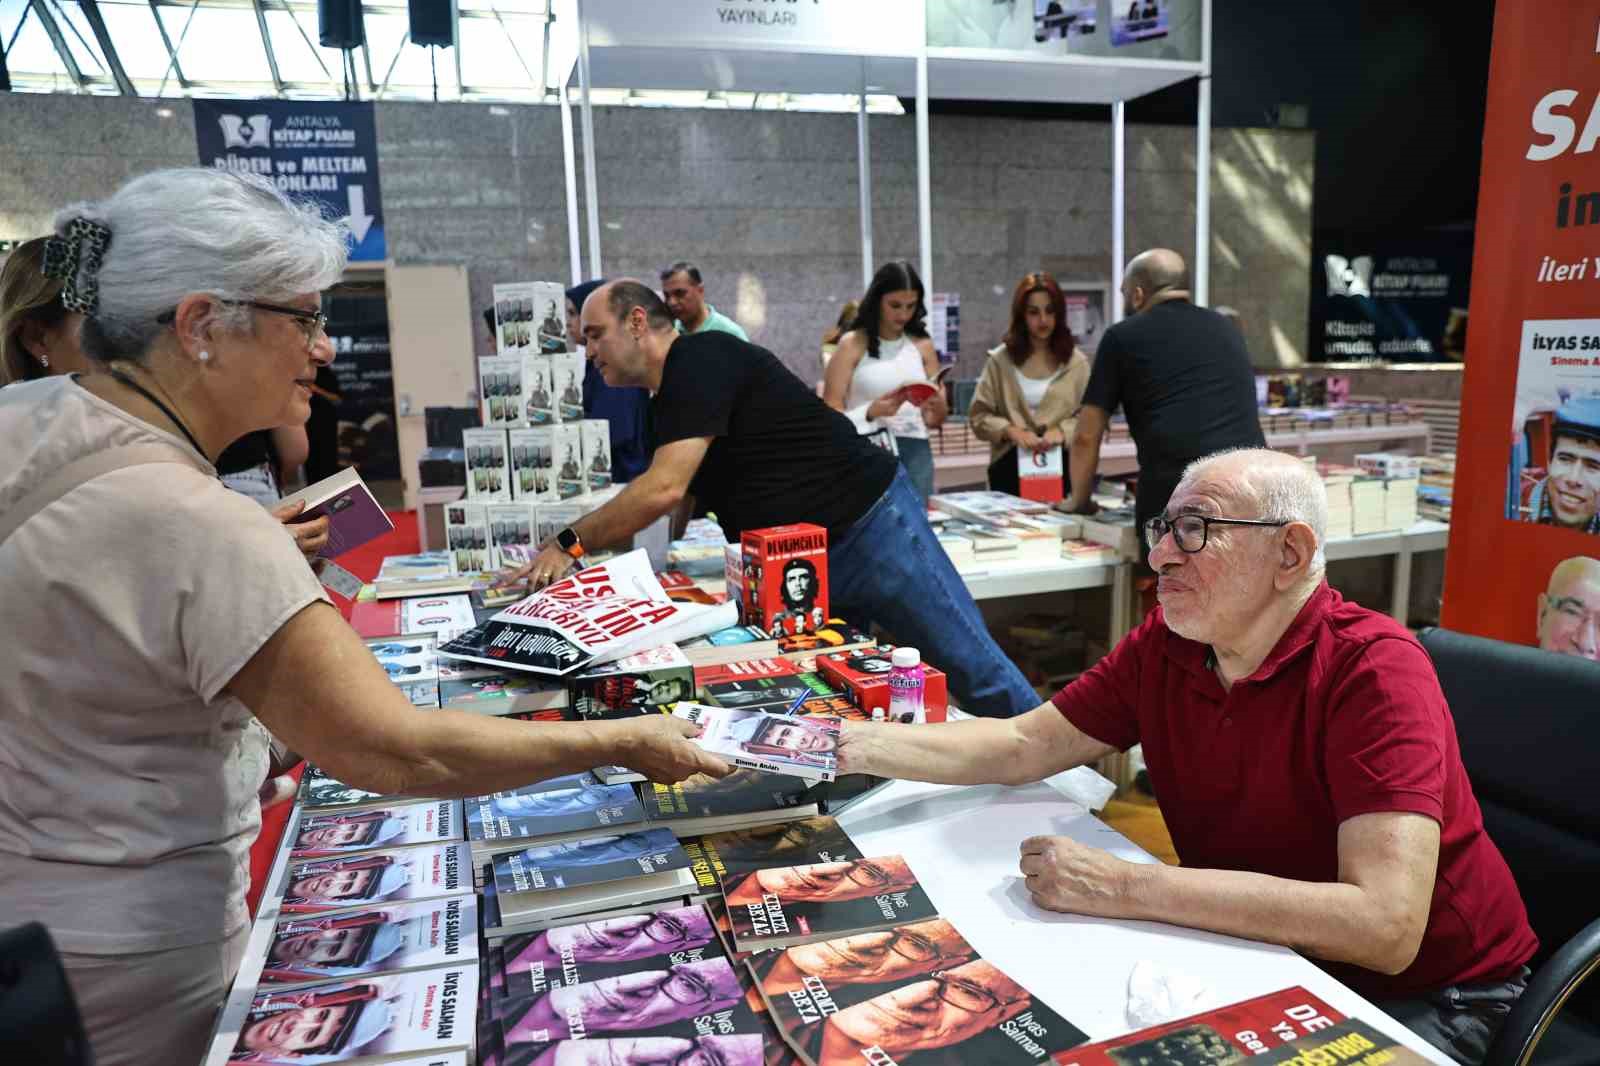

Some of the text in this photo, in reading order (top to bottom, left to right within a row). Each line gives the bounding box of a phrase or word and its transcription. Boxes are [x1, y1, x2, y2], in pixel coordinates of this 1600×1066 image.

[717, 8, 797, 25] YAYINLARI
[273, 128, 355, 142] KİTAP FUARI
[286, 116, 341, 128] ANTALYA
[214, 154, 367, 173] DÜDEN ve MELTEM
[1532, 332, 1577, 350] İLYAS
[1551, 357, 1589, 367] Sinema
[747, 902, 771, 936] BEYAZ
[762, 894, 789, 934] KIRMIZI
[445, 919, 459, 955] SALMAN
[443, 971, 463, 997] İLYAS
[437, 998, 457, 1039] SALMAN
[1015, 1011, 1047, 1037] Ilyas
[1000, 1020, 1046, 1059] Salman
